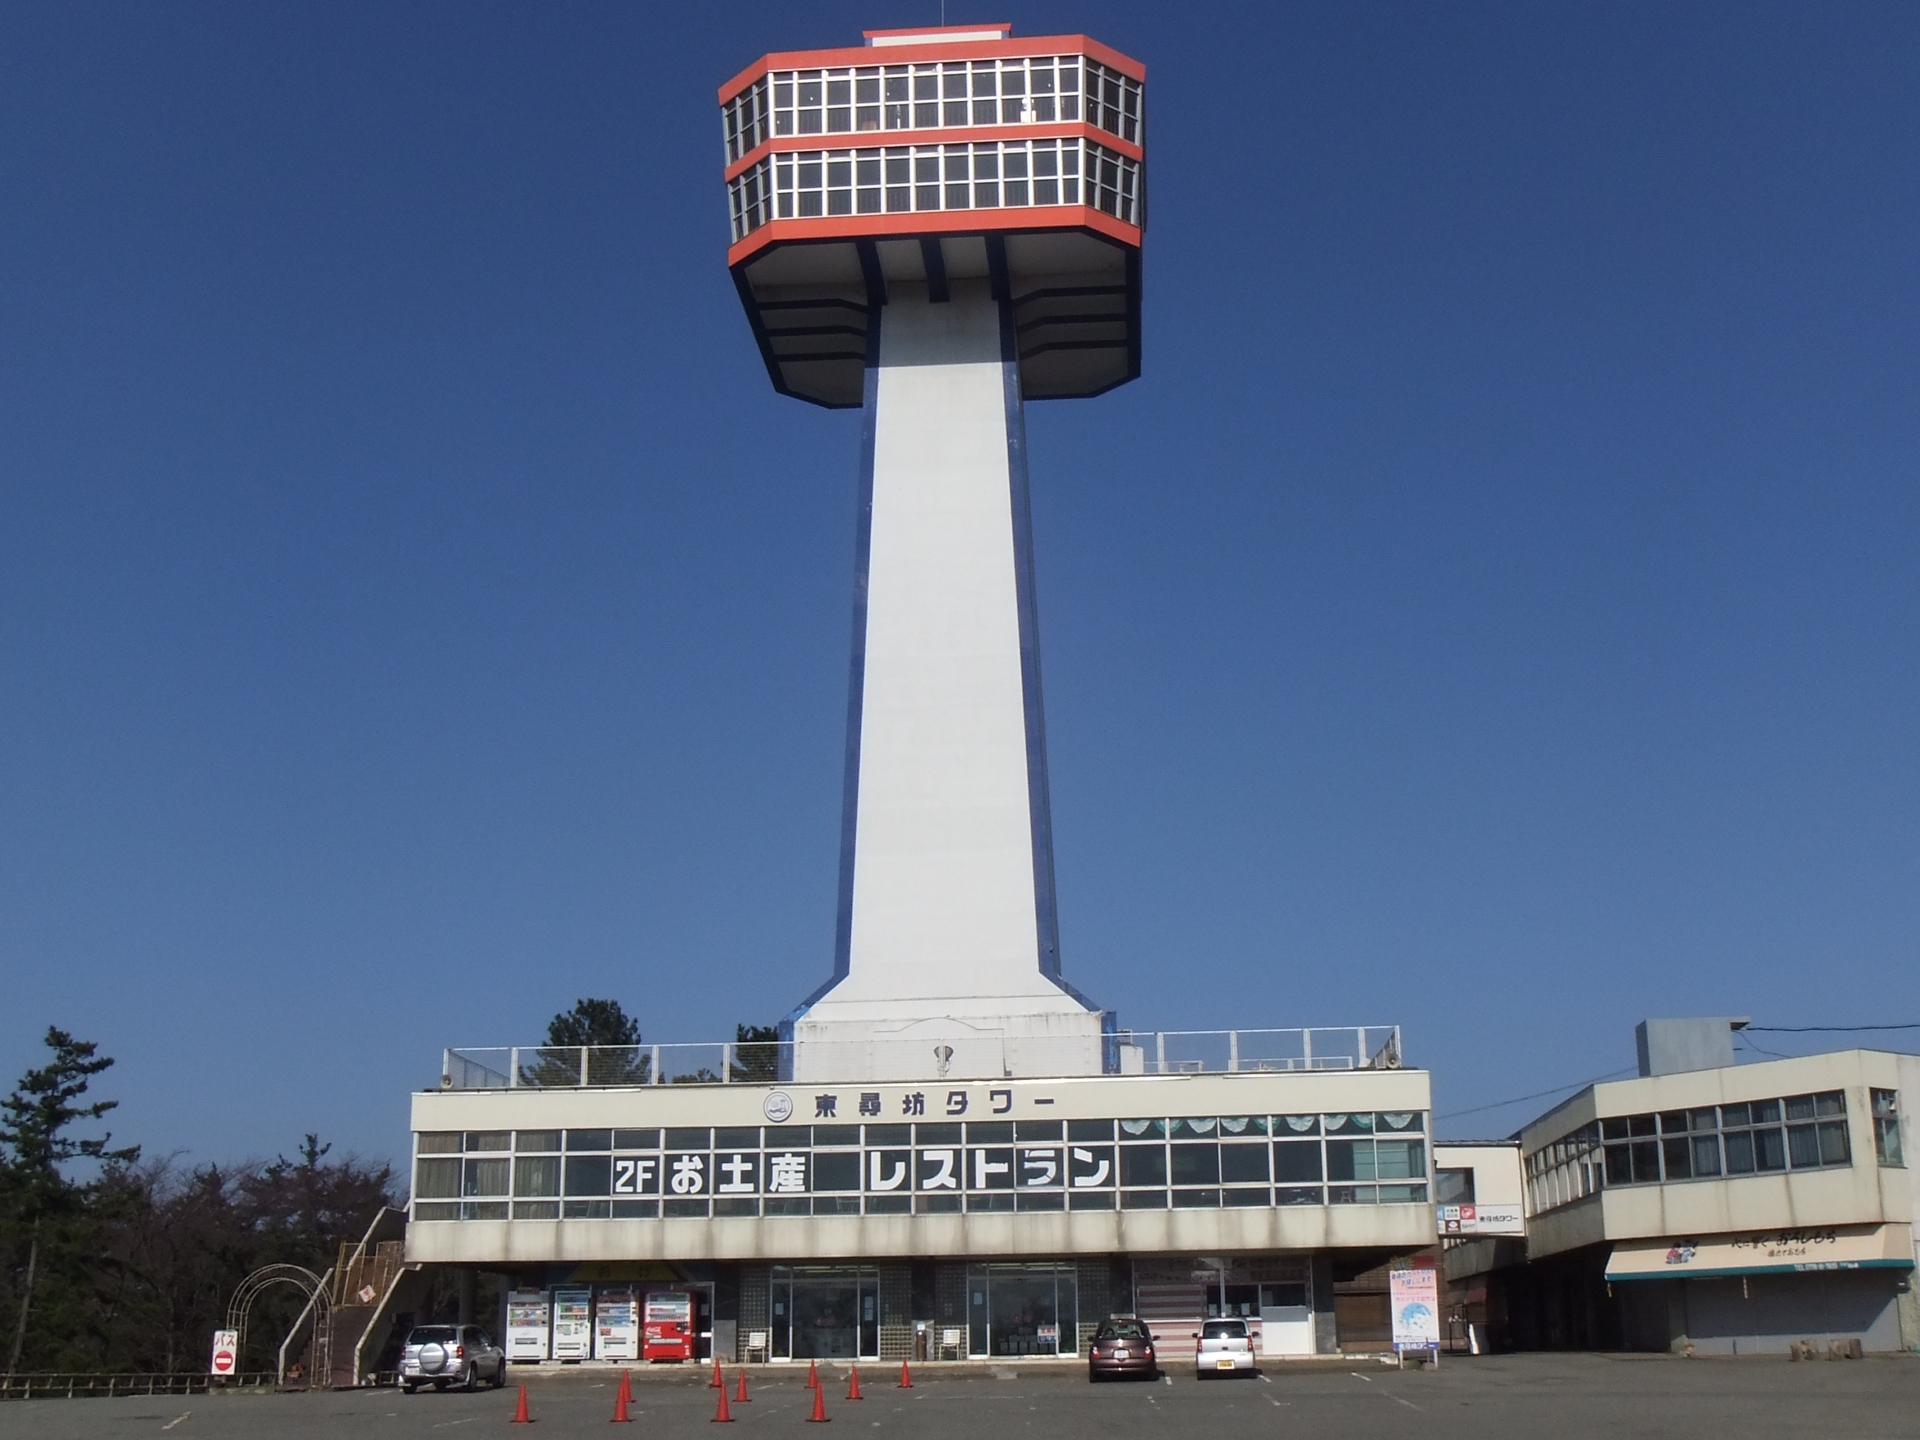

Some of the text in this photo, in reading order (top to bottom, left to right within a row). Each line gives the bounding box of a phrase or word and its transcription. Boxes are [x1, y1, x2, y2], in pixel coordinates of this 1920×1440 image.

[814, 1089, 1055, 1118] 東尋坊タワー
[870, 1147, 1110, 1191] レストラン
